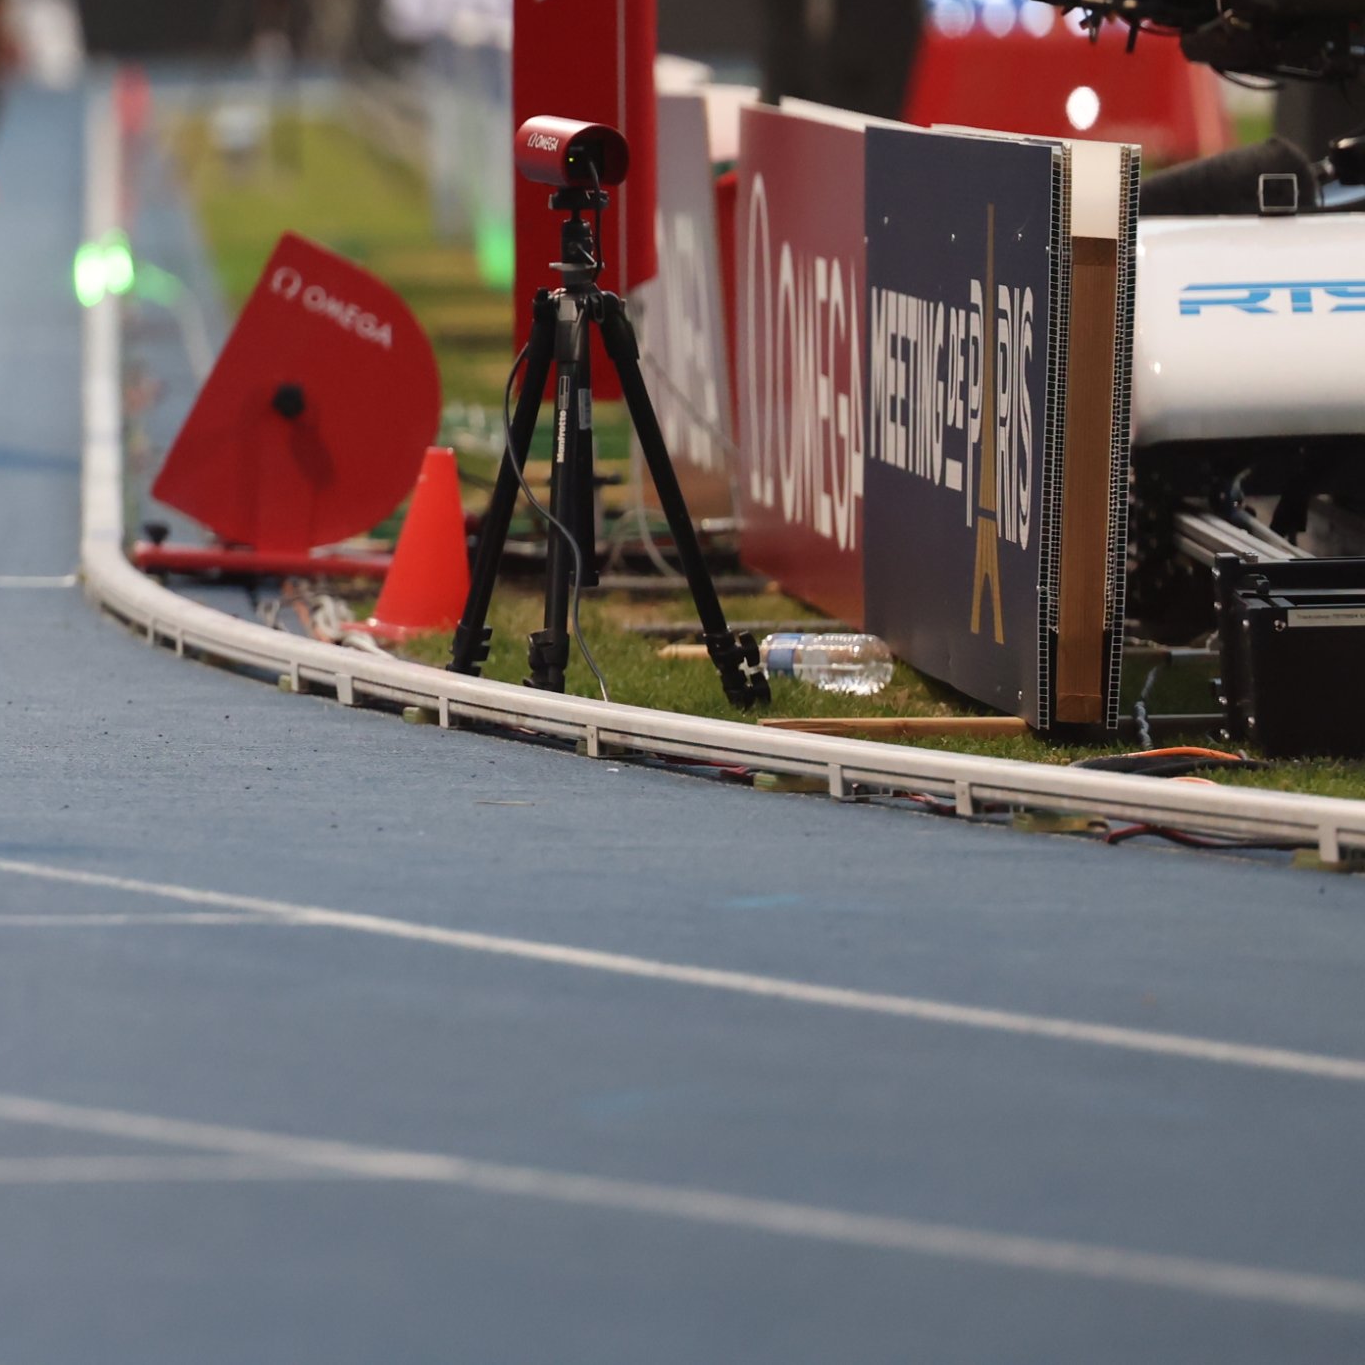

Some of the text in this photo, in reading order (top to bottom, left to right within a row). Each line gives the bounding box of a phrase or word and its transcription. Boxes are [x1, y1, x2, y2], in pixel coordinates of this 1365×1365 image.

[535, 135, 559, 152] OMEGA
[302, 284, 393, 350] OMEGA
[777, 239, 865, 552] OMEGA
[870, 285, 944, 486] MEETING
[947, 306, 966, 430] DE
